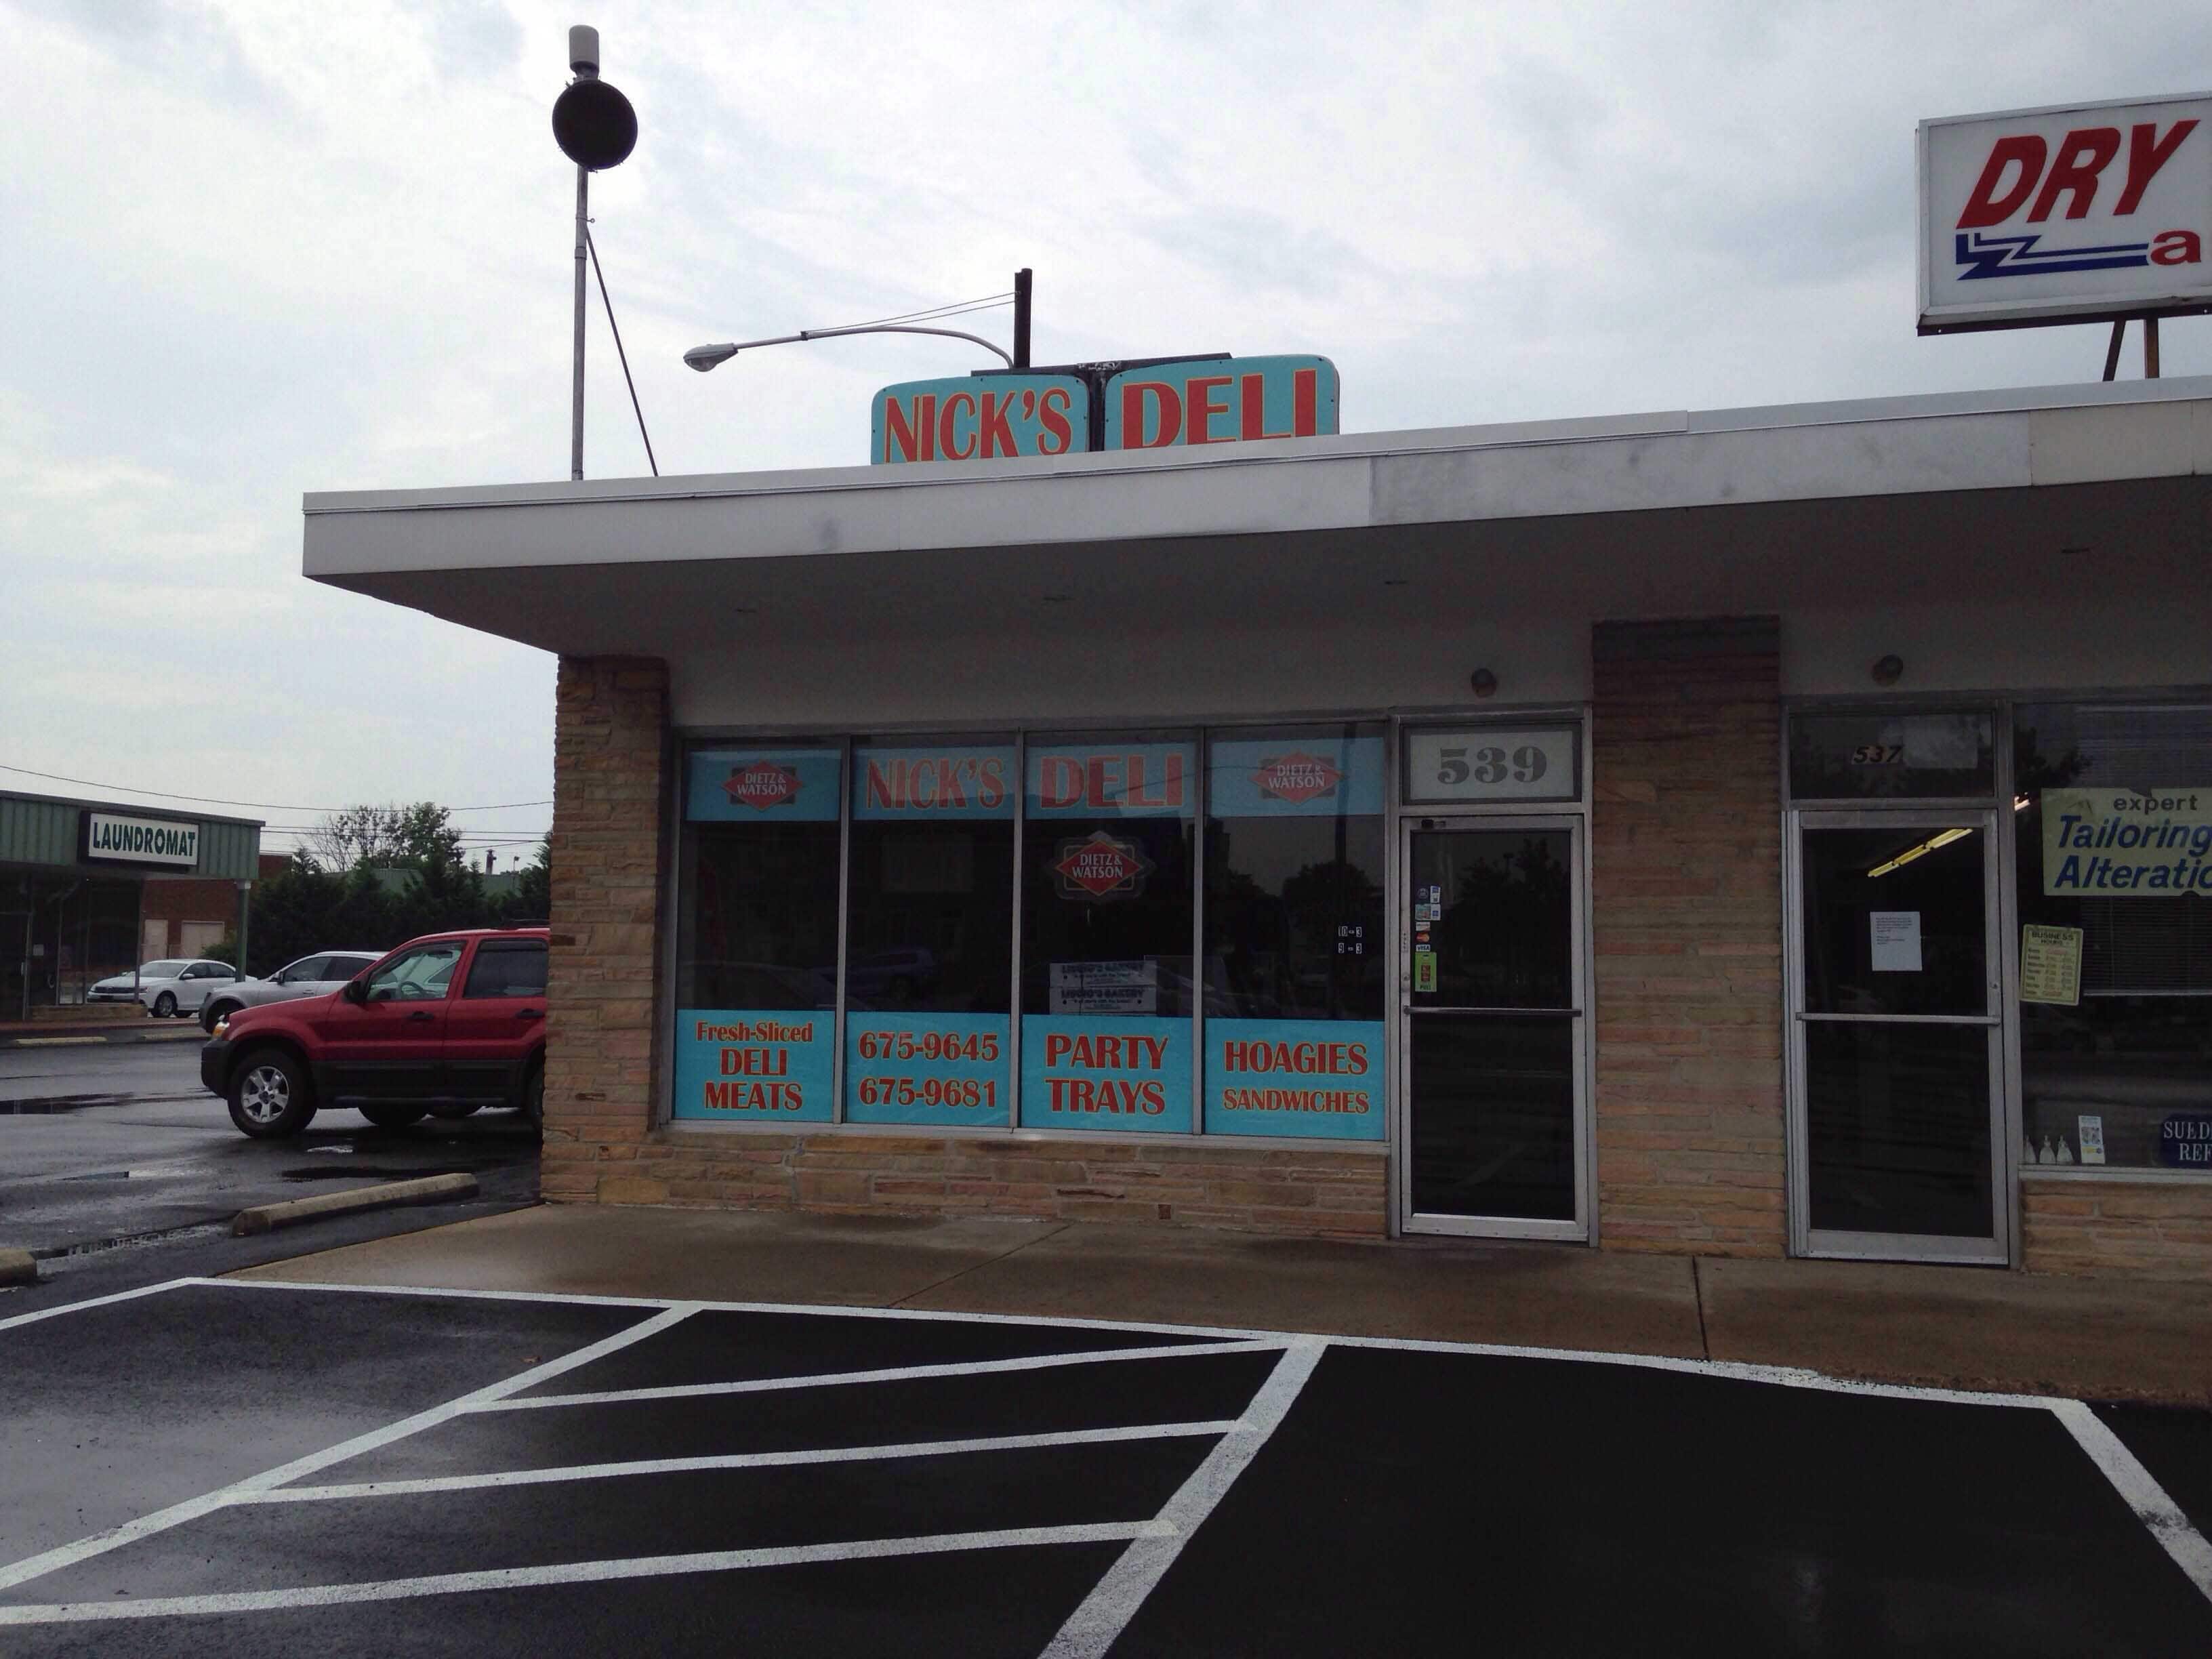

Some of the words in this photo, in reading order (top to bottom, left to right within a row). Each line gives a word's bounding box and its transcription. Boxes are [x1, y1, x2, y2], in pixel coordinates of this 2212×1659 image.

[1956, 119, 2201, 229] DRY
[884, 388, 1072, 464] NICK'S
[1122, 369, 1317, 451] DELI
[1437, 745, 1548, 785] 539
[1853, 746, 1902, 763] 537
[745, 772, 776, 783] DIETZ
[777, 773, 786, 783] &
[866, 758, 1004, 810] NICK'S
[1040, 752, 1183, 809] DELI
[1268, 775, 1326, 789] WATSON
[1276, 764, 1313, 777] DIETZ
[1315, 764, 1324, 775] &
[737, 783, 787, 796] WATSON
[2113, 794, 2198, 815] expert
[93, 821, 196, 857] LAUNDROMAT
[2057, 815, 2212, 857] Tailoring
[1072, 865, 1124, 879] WATSON
[1079, 854, 1113, 866] DIETZ
[1113, 855, 1122, 865] &
[2032, 931, 2074, 941] BUSINESS
[696, 1021, 813, 1042] Fresh-Sliced
[859, 1031, 1000, 1062] 675-9645
[1046, 1034, 1168, 1070] PARTY
[1224, 1041, 1369, 1075] HOAGIES
[720, 1048, 788, 1076] DELI
[704, 1081, 803, 1111] MEATS
[859, 1078, 996, 1107] 675-9681
[1045, 1078, 1166, 1115] TRAYS
[1223, 1088, 1370, 1115] SANDWICHES
[2163, 1121, 2212, 1139] SUED
